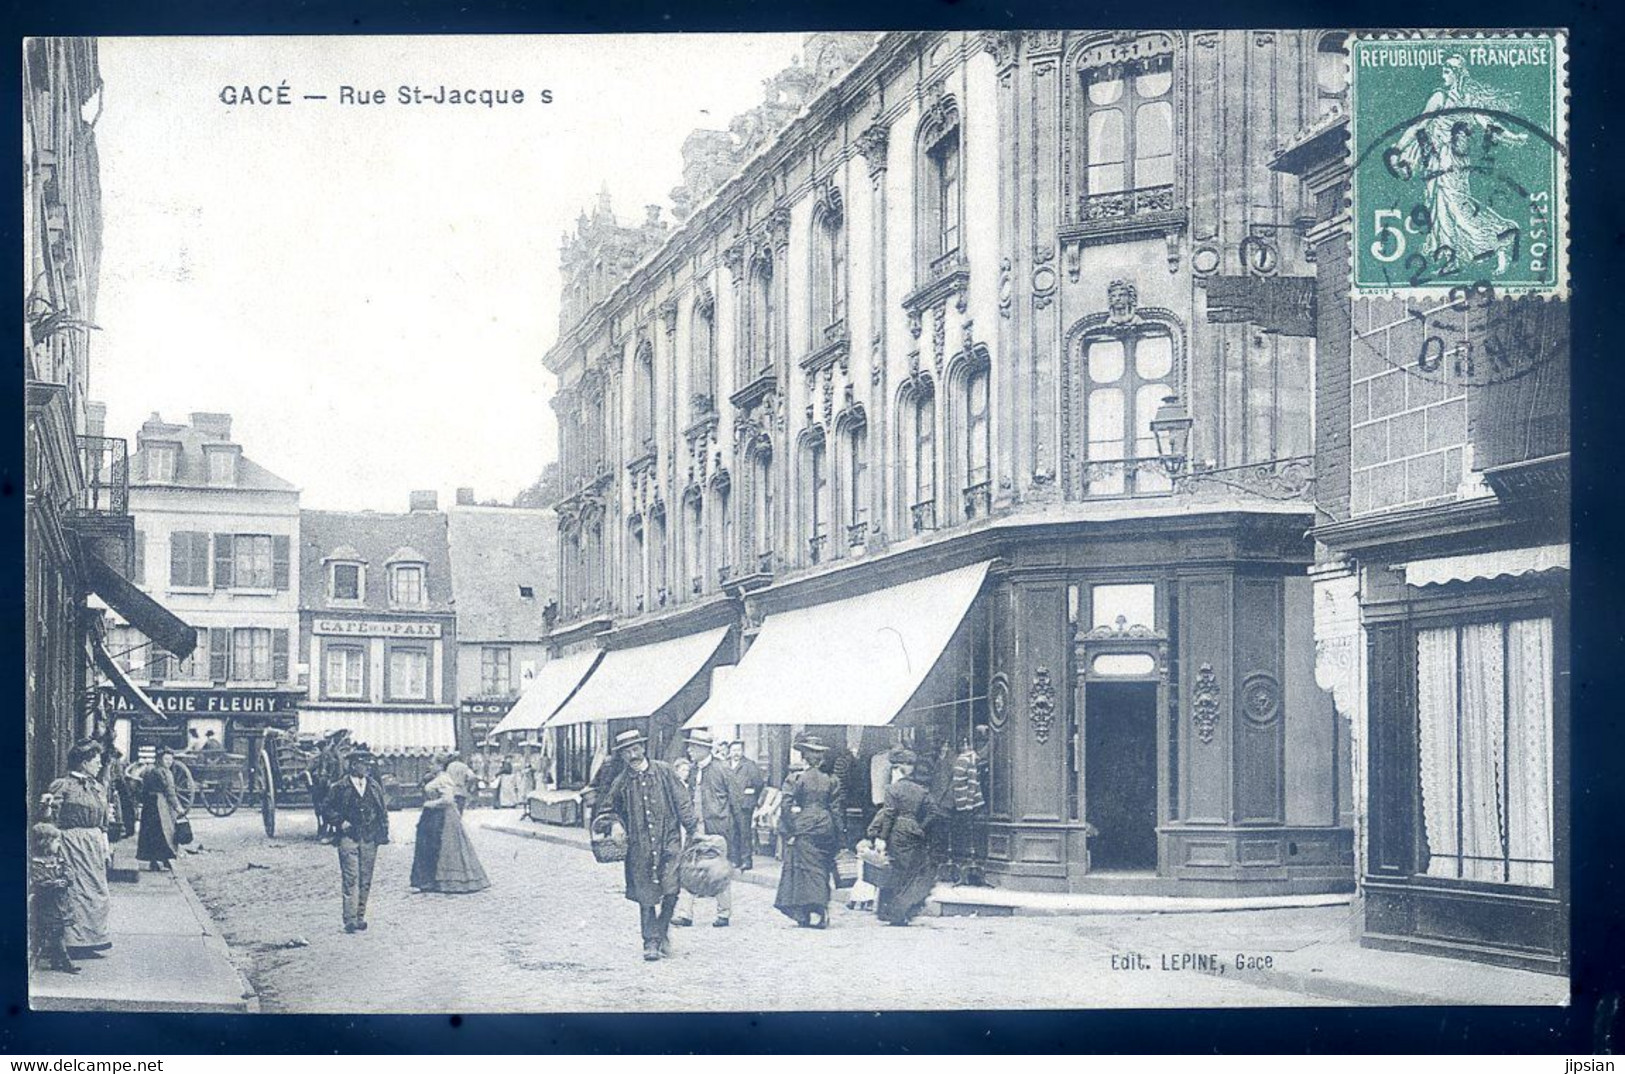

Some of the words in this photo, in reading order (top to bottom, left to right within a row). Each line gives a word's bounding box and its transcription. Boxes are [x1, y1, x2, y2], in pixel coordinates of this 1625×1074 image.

[1469, 48, 1548, 67] FRANÇAISE
[220, 80, 291, 105] GACÉ
[339, 86, 387, 104] Rue
[1529, 191, 1549, 272] POSTES
[394, 624, 437, 635] PAIX
[208, 696, 276, 711] FLEURY
[1111, 953, 1151, 971] Edit.
[1161, 953, 1226, 974] LEPINE,
[1235, 953, 1273, 971] Gace
